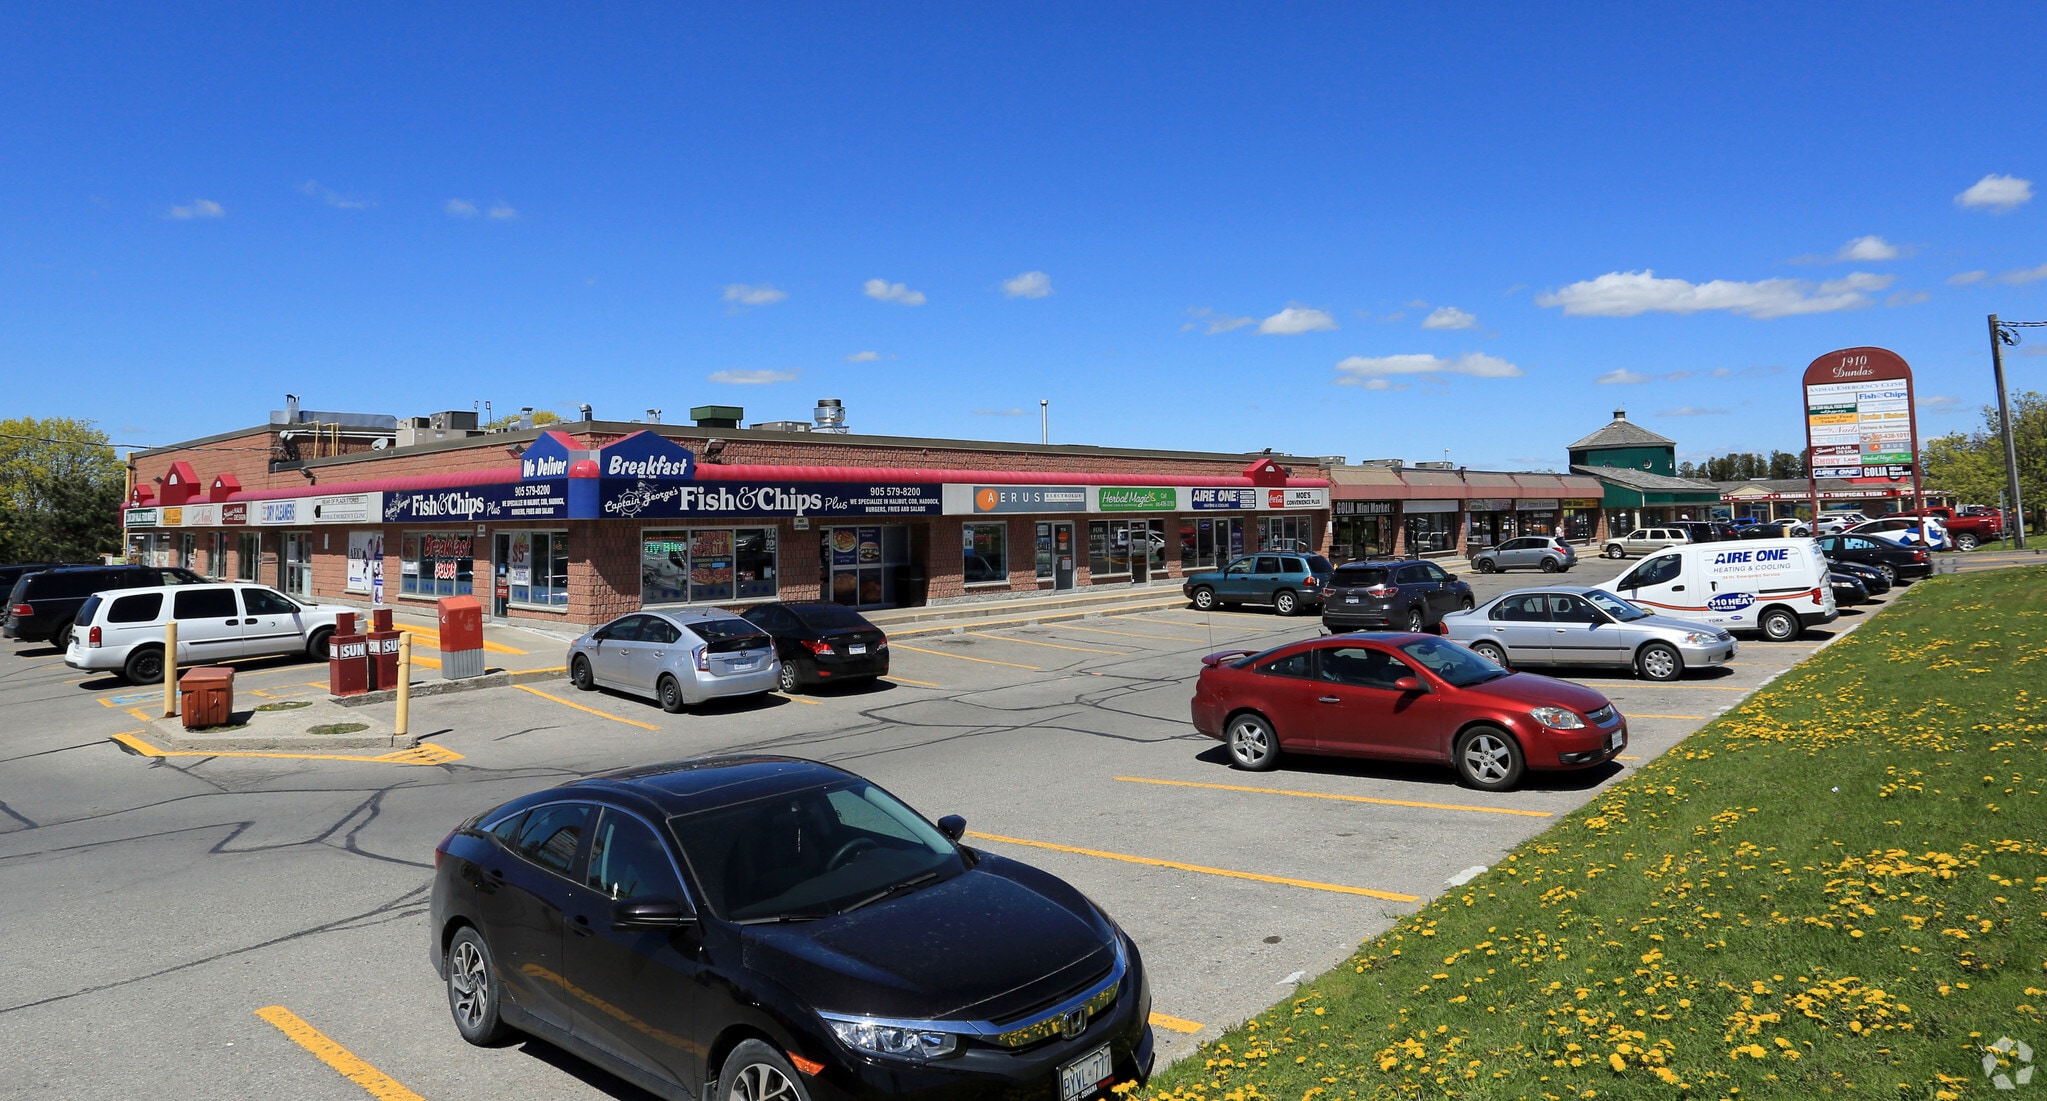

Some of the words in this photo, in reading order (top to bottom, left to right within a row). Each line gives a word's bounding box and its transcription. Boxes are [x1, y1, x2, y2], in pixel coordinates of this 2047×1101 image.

[1841, 356, 1868, 368] 1910
[1832, 366, 1874, 378] Dundas
[524, 459, 535, 477] We
[537, 456, 566, 476] Deliver
[608, 455, 687, 475] Breakfast
[1864, 467, 1888, 477] GOLIA
[515, 486, 525, 496] 905
[526, 484, 550, 496] 579-8200
[870, 487, 884, 496] 905
[886, 487, 920, 496] 579-8200
[1193, 490, 1216, 502] AIRE
[1218, 490, 1237, 502] ONE
[604, 498, 640, 513] Captain
[642, 486, 679, 507] George's
[824, 496, 848, 512] Plus
[987, 492, 1040, 502] AERUS
[1102, 490, 1129, 503] Herbal
[1129, 491, 1150, 508] Magic
[487, 501, 500, 516] Plus
[1336, 501, 1355, 514] GOLIA
[1356, 502, 1370, 513] Mini
[1370, 502, 1390, 513] Market
[695, 531, 728, 543] LUNCH
[424, 532, 471, 558] Breakfast
[1037, 542, 1050, 550] SALE
[1714, 551, 1752, 564] AIRE
[1756, 549, 1789, 561] ONE
[691, 569, 732, 580] $6.99
[1714, 565, 1746, 574] HEATING
[344, 644, 365, 657] SUN
[385, 640, 399, 652] SU
[1093, 1054, 1110, 1080] 777
